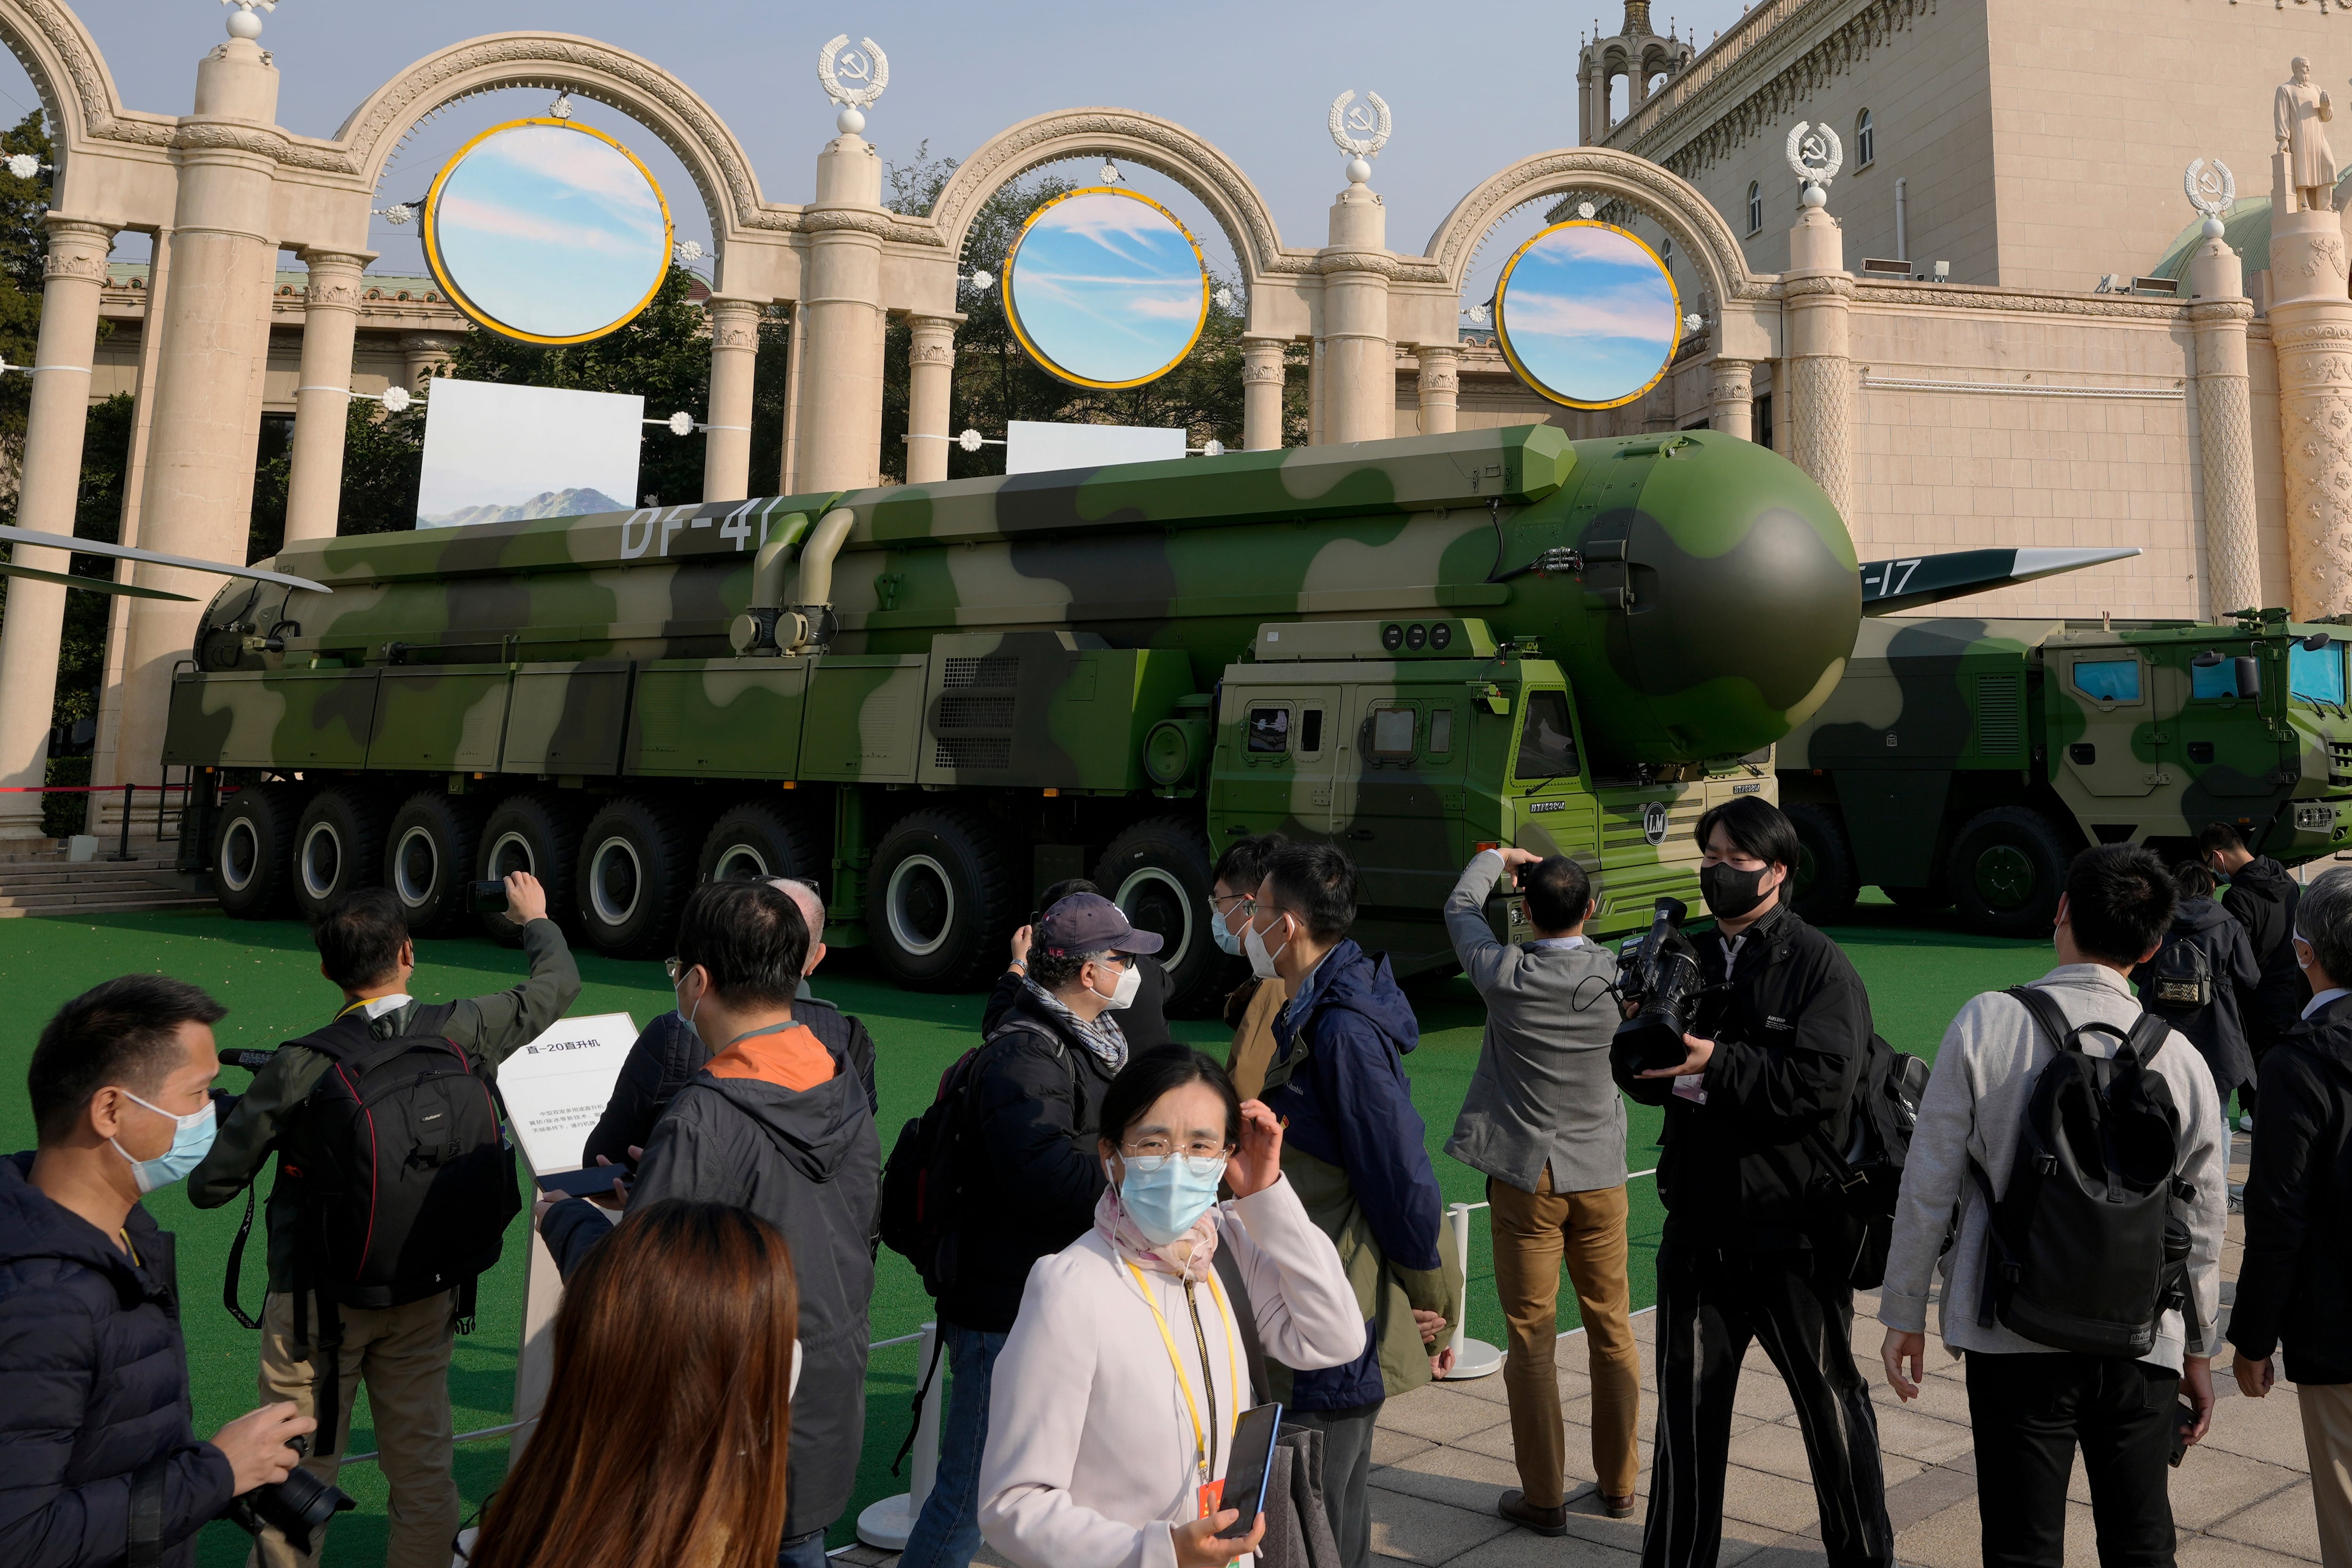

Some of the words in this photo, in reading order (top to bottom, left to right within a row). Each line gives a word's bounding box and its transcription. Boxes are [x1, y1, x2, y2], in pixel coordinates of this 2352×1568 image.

[620, 495, 785, 559] DF-41
[1859, 559, 1922, 596] -17
[1648, 814, 1664, 833] LM
[525, 1039, 601, 1054] 直-20直升机
[243, 1192, 253, 1234] ONY
